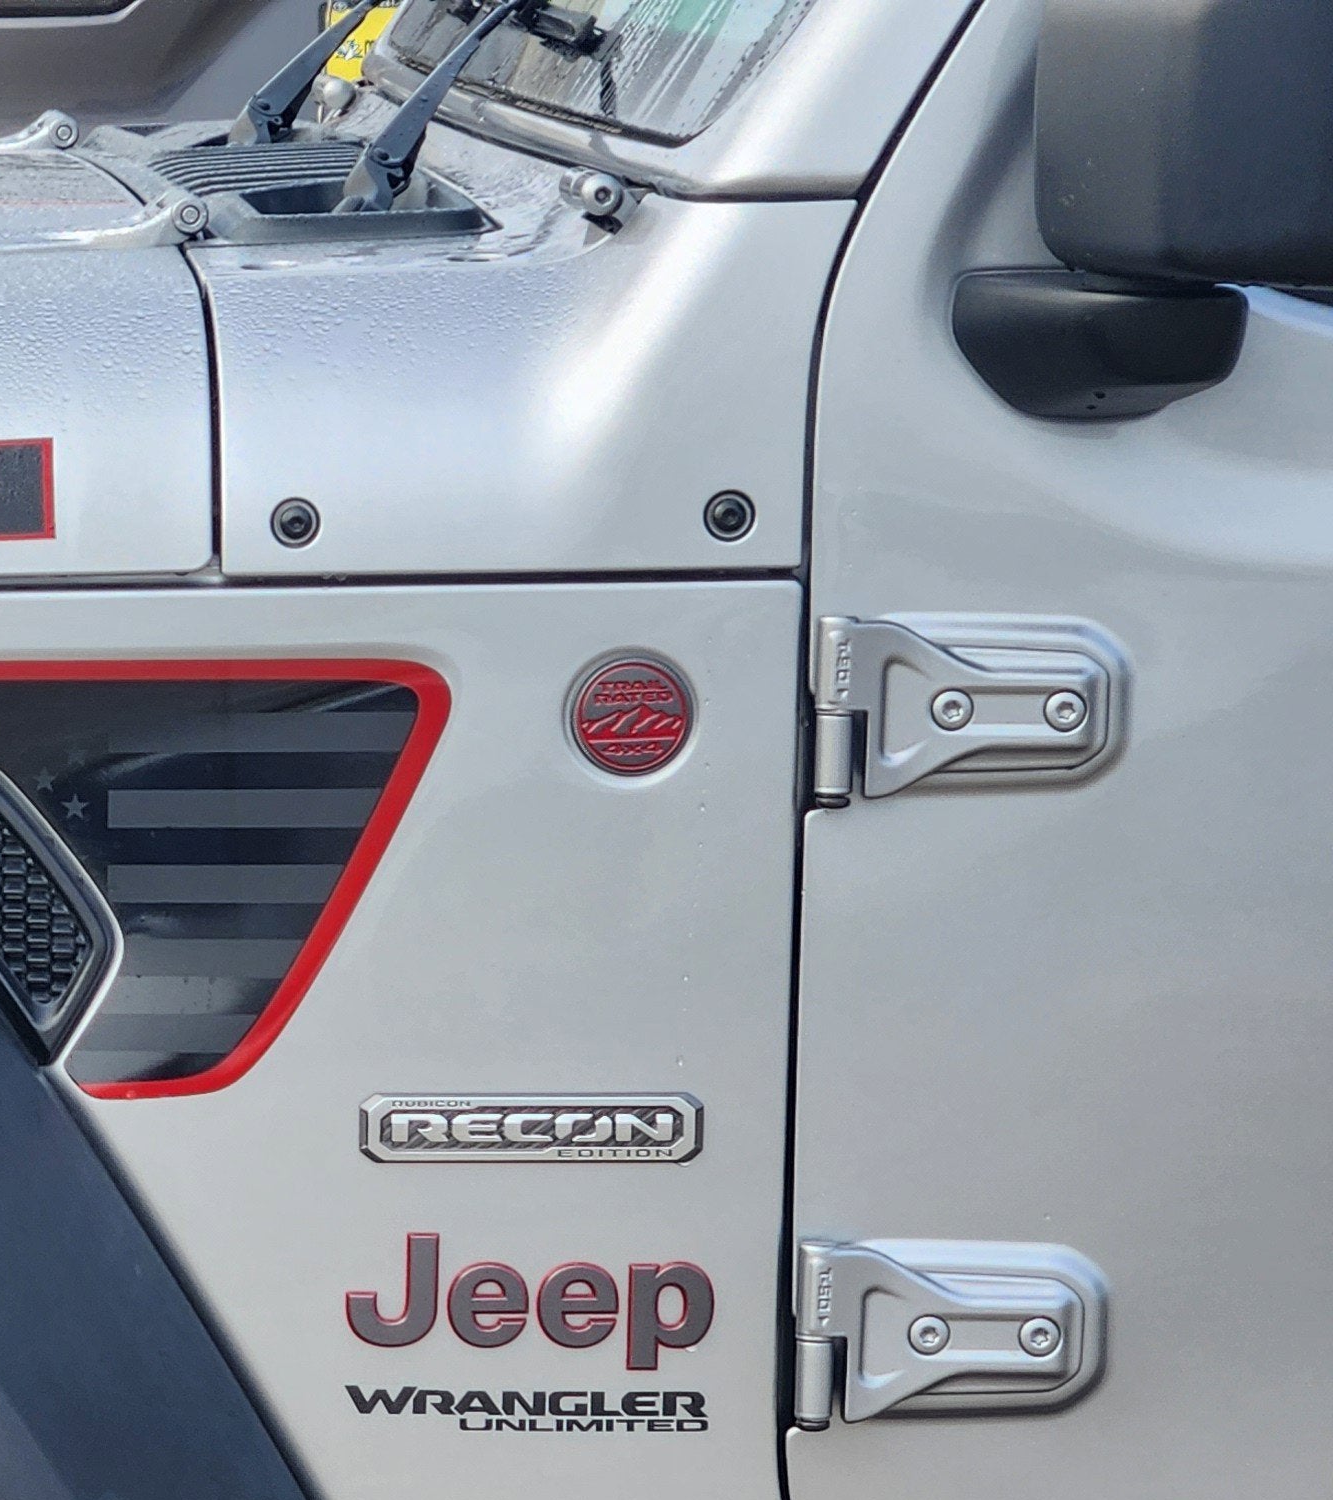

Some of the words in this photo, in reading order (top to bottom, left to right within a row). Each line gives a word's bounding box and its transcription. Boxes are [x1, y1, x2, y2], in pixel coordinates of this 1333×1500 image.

[593, 690, 674, 706] RATED
[391, 1099, 472, 1108] RUBICON
[389, 1112, 675, 1144] RECON
[556, 1147, 674, 1158] EDITION
[344, 1231, 716, 1371] Jeep
[343, 1384, 710, 1418] WRANGLER
[458, 1418, 709, 1432] UNLIMITED
